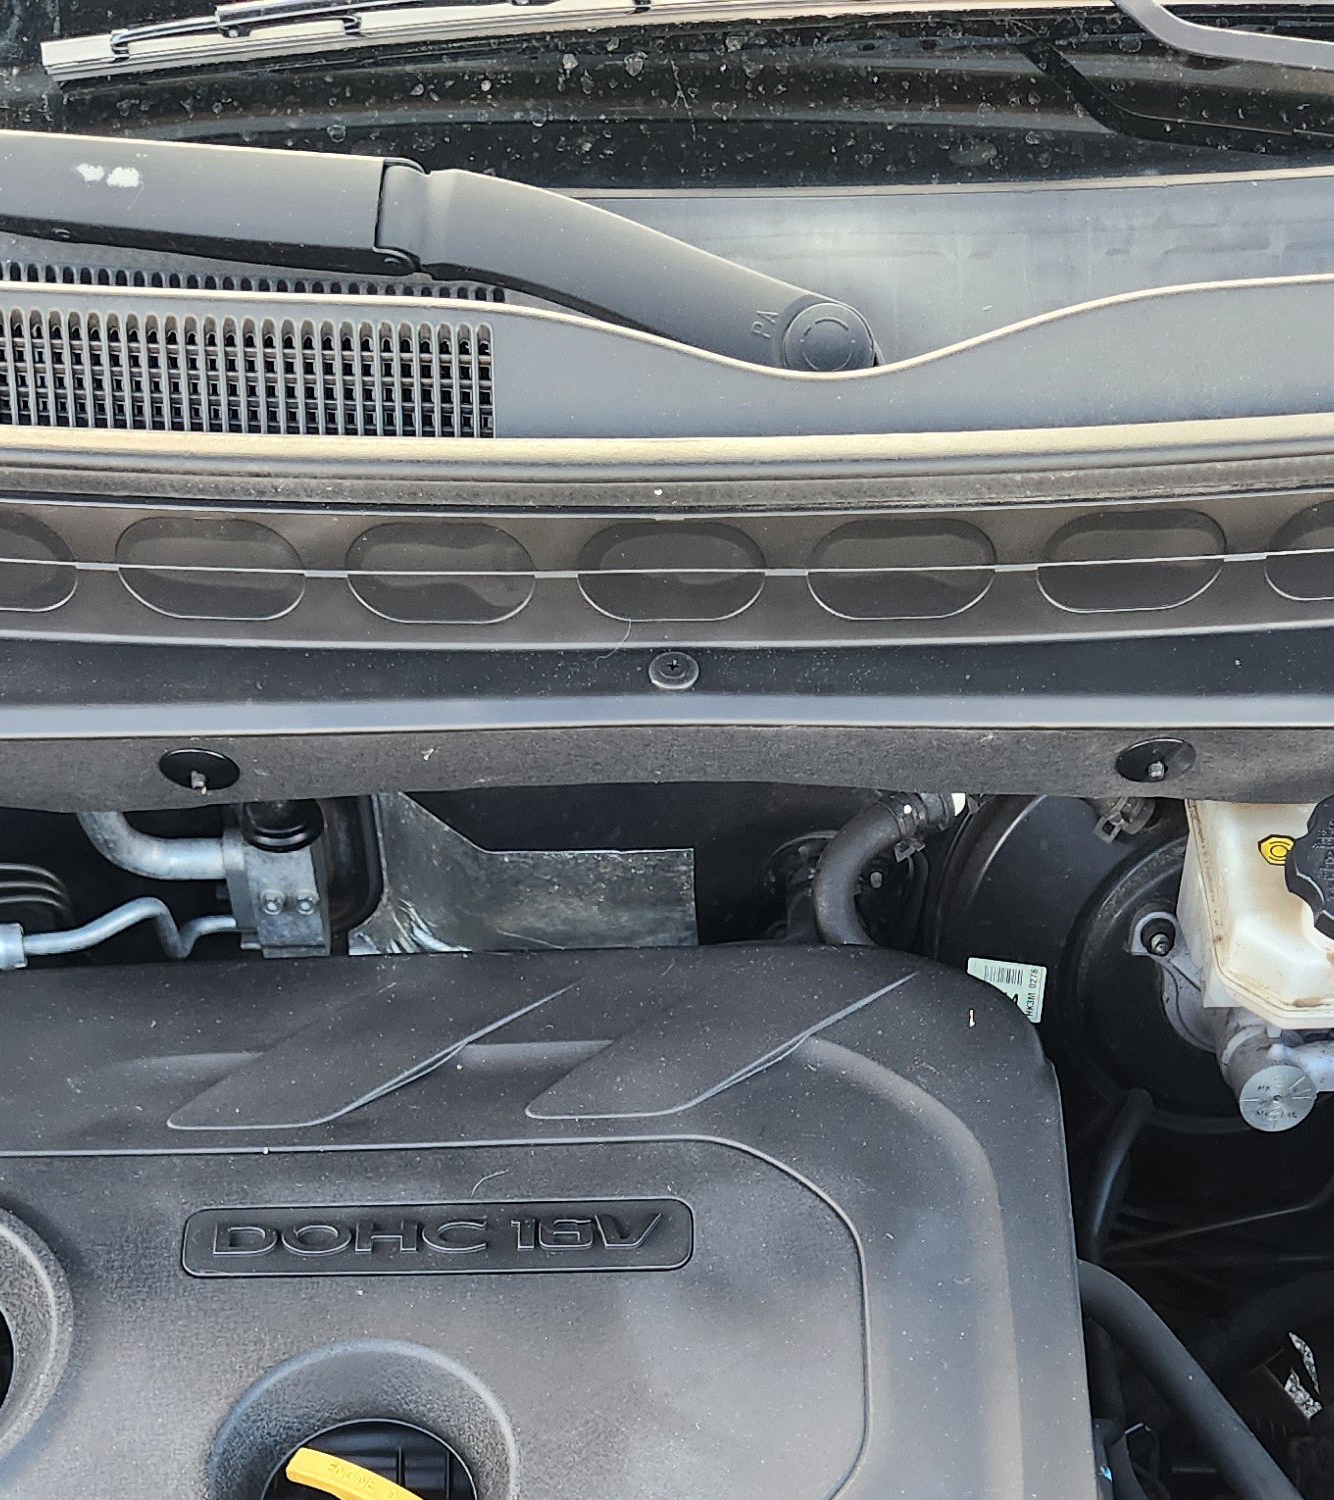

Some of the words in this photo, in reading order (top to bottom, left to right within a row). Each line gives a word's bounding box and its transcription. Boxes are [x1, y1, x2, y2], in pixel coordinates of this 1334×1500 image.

[212, 1214, 487, 1256] DOHC
[510, 1211, 662, 1251] 16V
[327, 1462, 377, 1490] ENGINE
